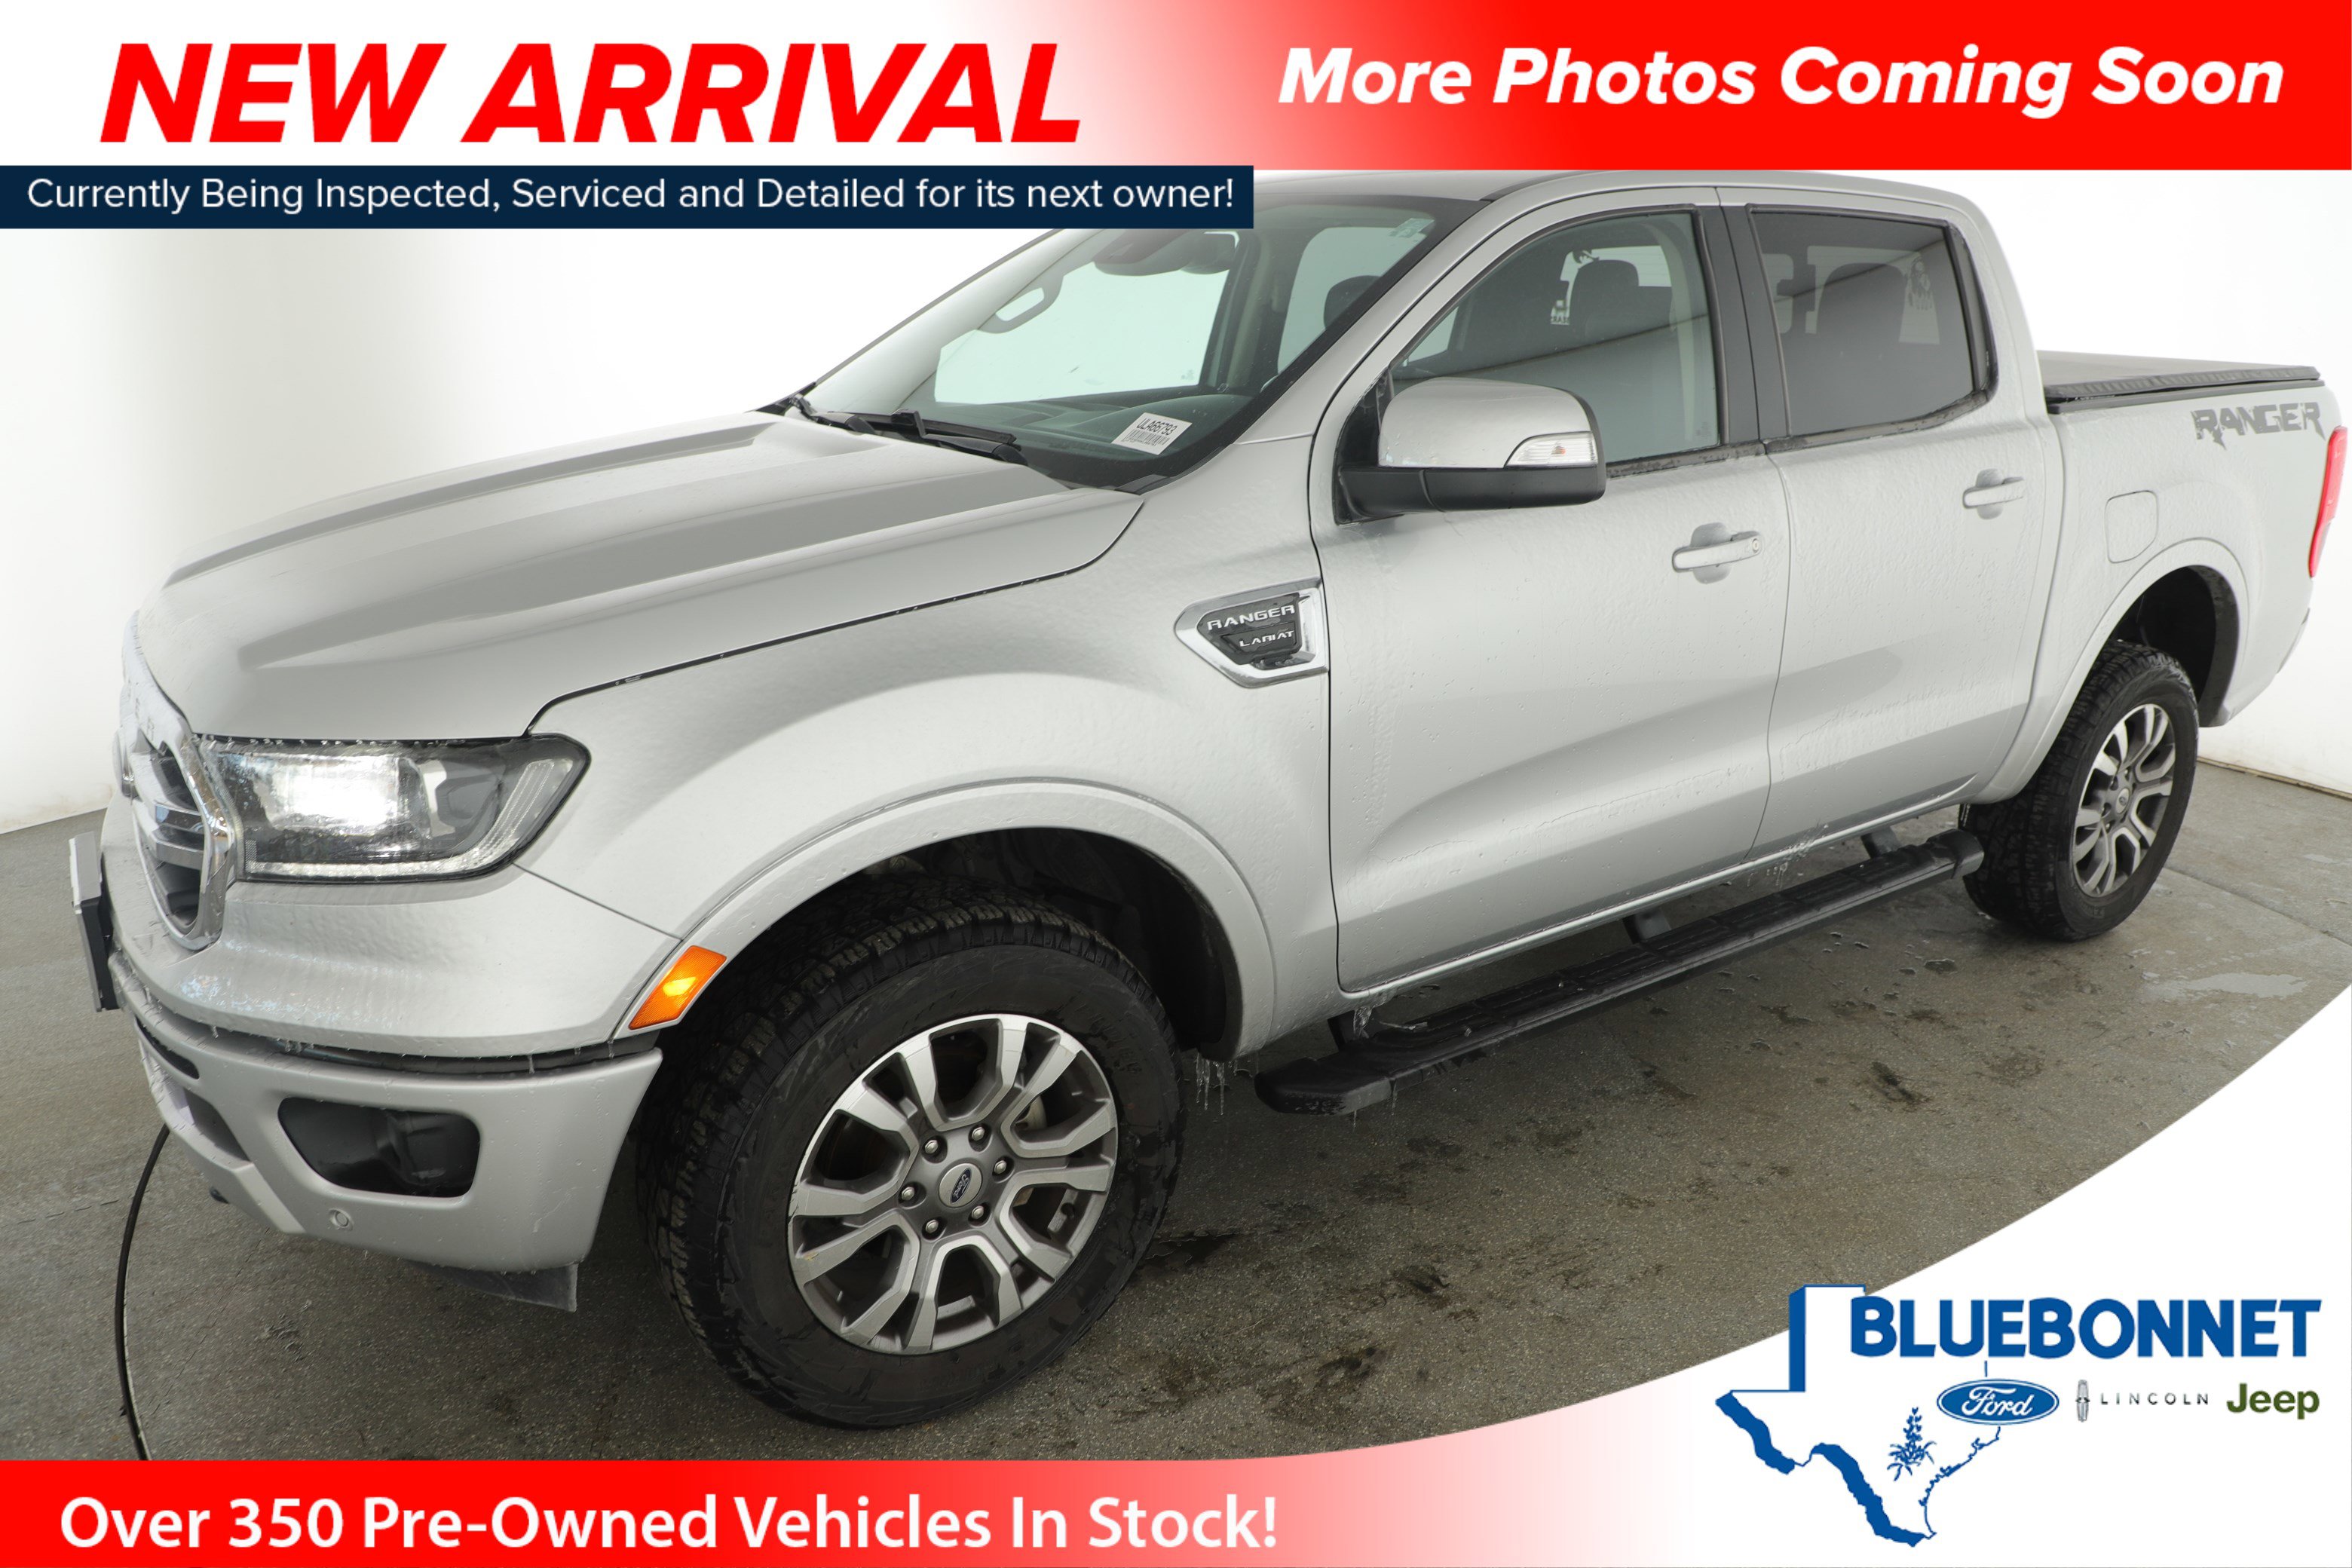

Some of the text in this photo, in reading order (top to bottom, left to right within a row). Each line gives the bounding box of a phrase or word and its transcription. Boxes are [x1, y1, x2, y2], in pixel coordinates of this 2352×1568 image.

[1136, 417, 1178, 436] ULA66793
[2191, 402, 2326, 449] RANGER
[1206, 604, 1296, 631] RANGER
[1239, 629, 1295, 648] LARIAT
